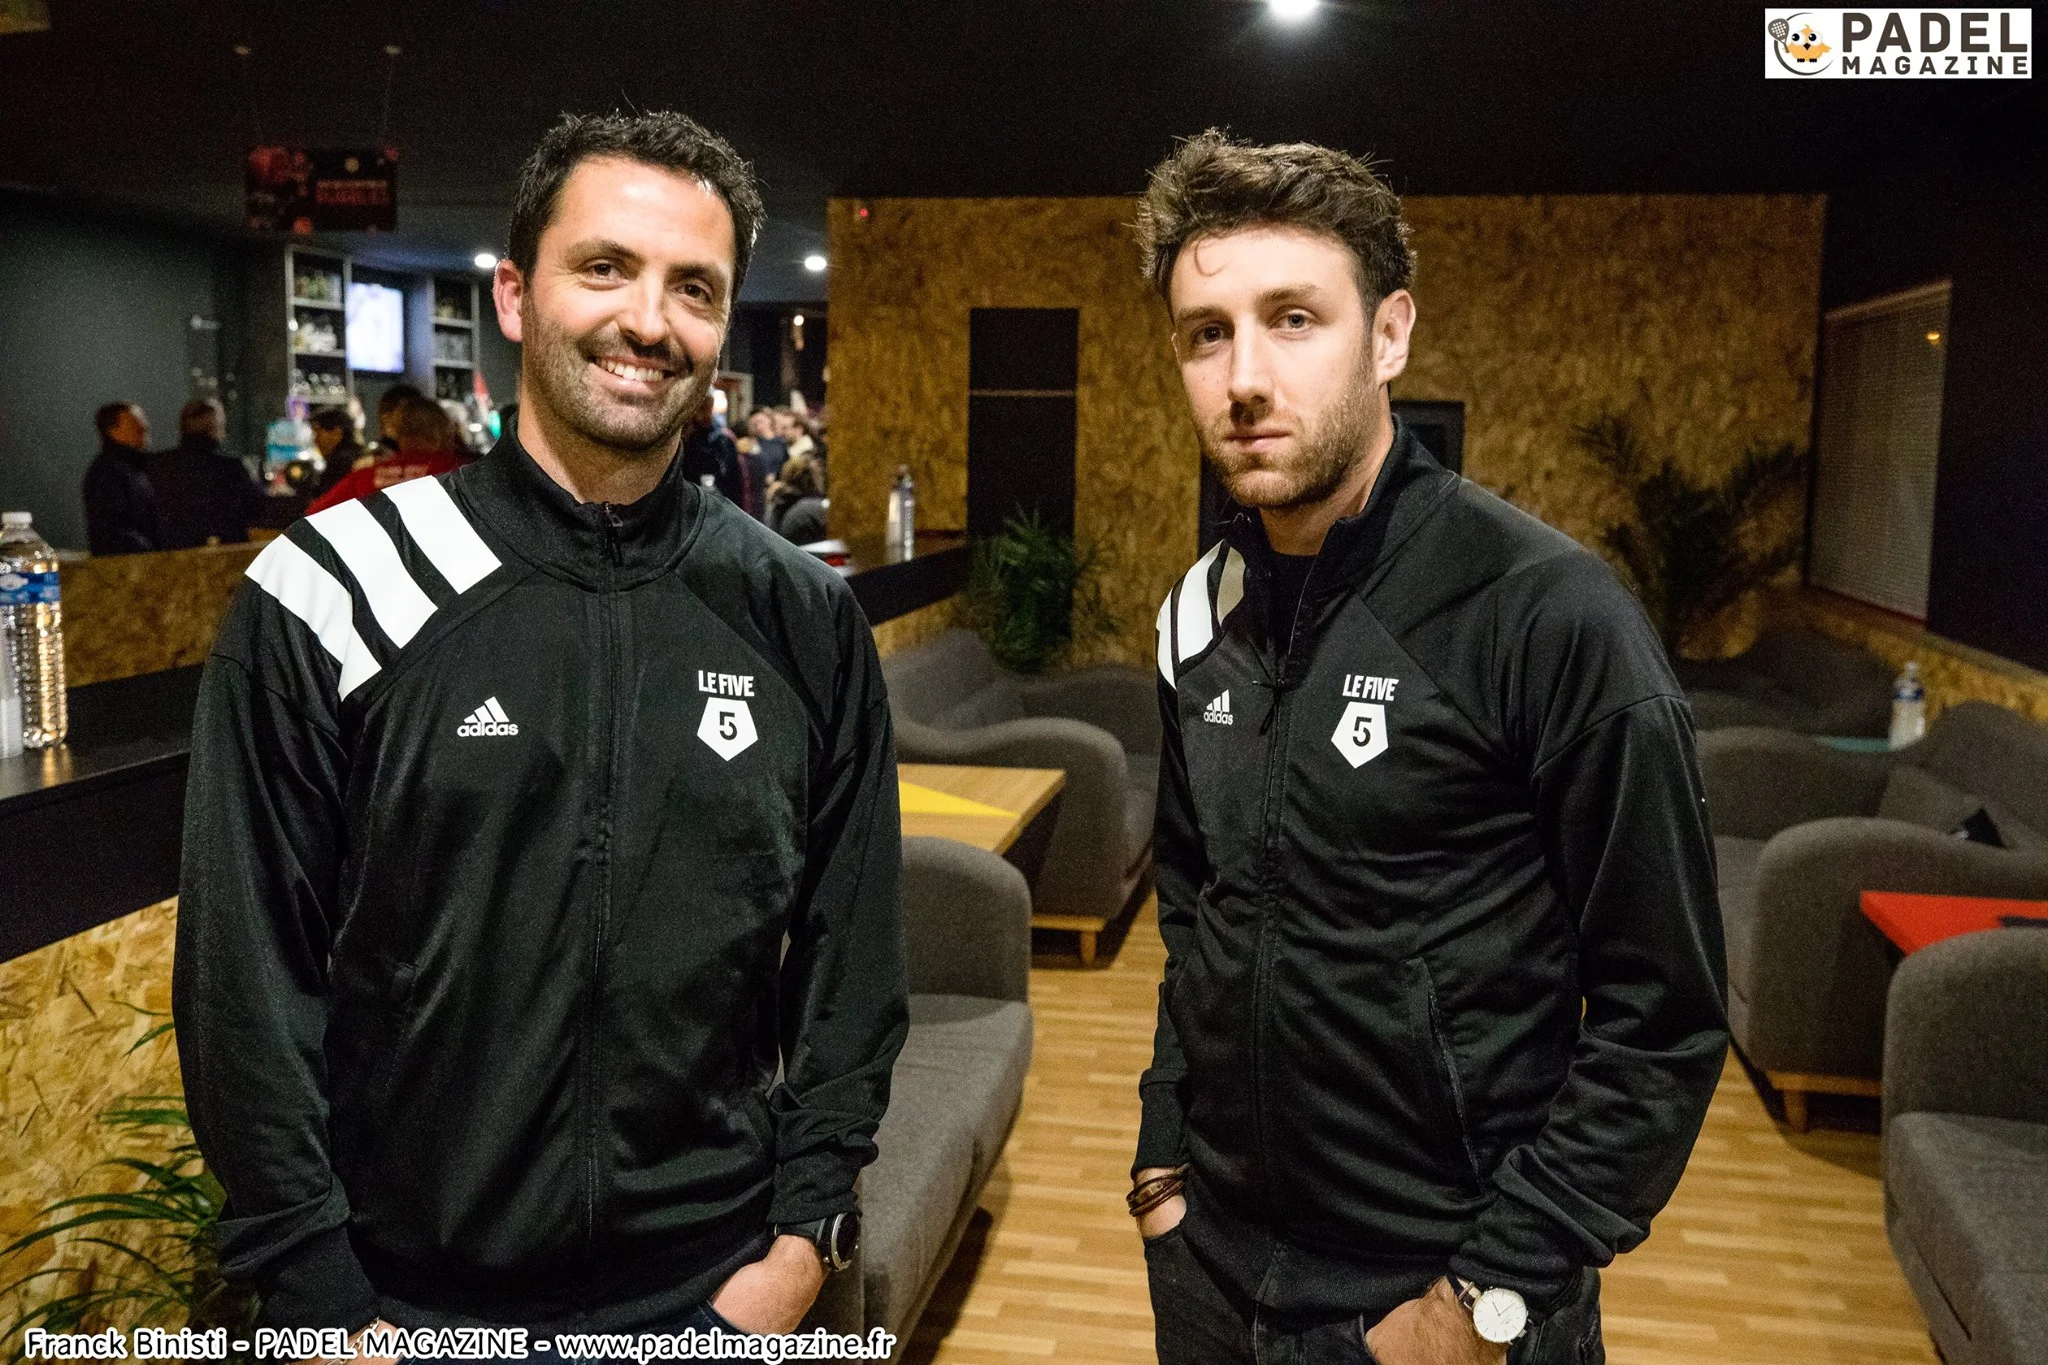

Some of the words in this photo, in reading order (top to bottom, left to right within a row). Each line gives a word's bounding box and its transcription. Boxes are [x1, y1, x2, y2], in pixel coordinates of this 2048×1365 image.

[698, 670, 717, 693] LE
[718, 673, 755, 697] FIVE
[1342, 674, 1364, 698] LE
[1362, 676, 1399, 701] FIVE
[457, 722, 519, 737] adidas
[719, 711, 738, 741] 5
[1203, 710, 1233, 726] adidas
[1352, 716, 1372, 747] 5
